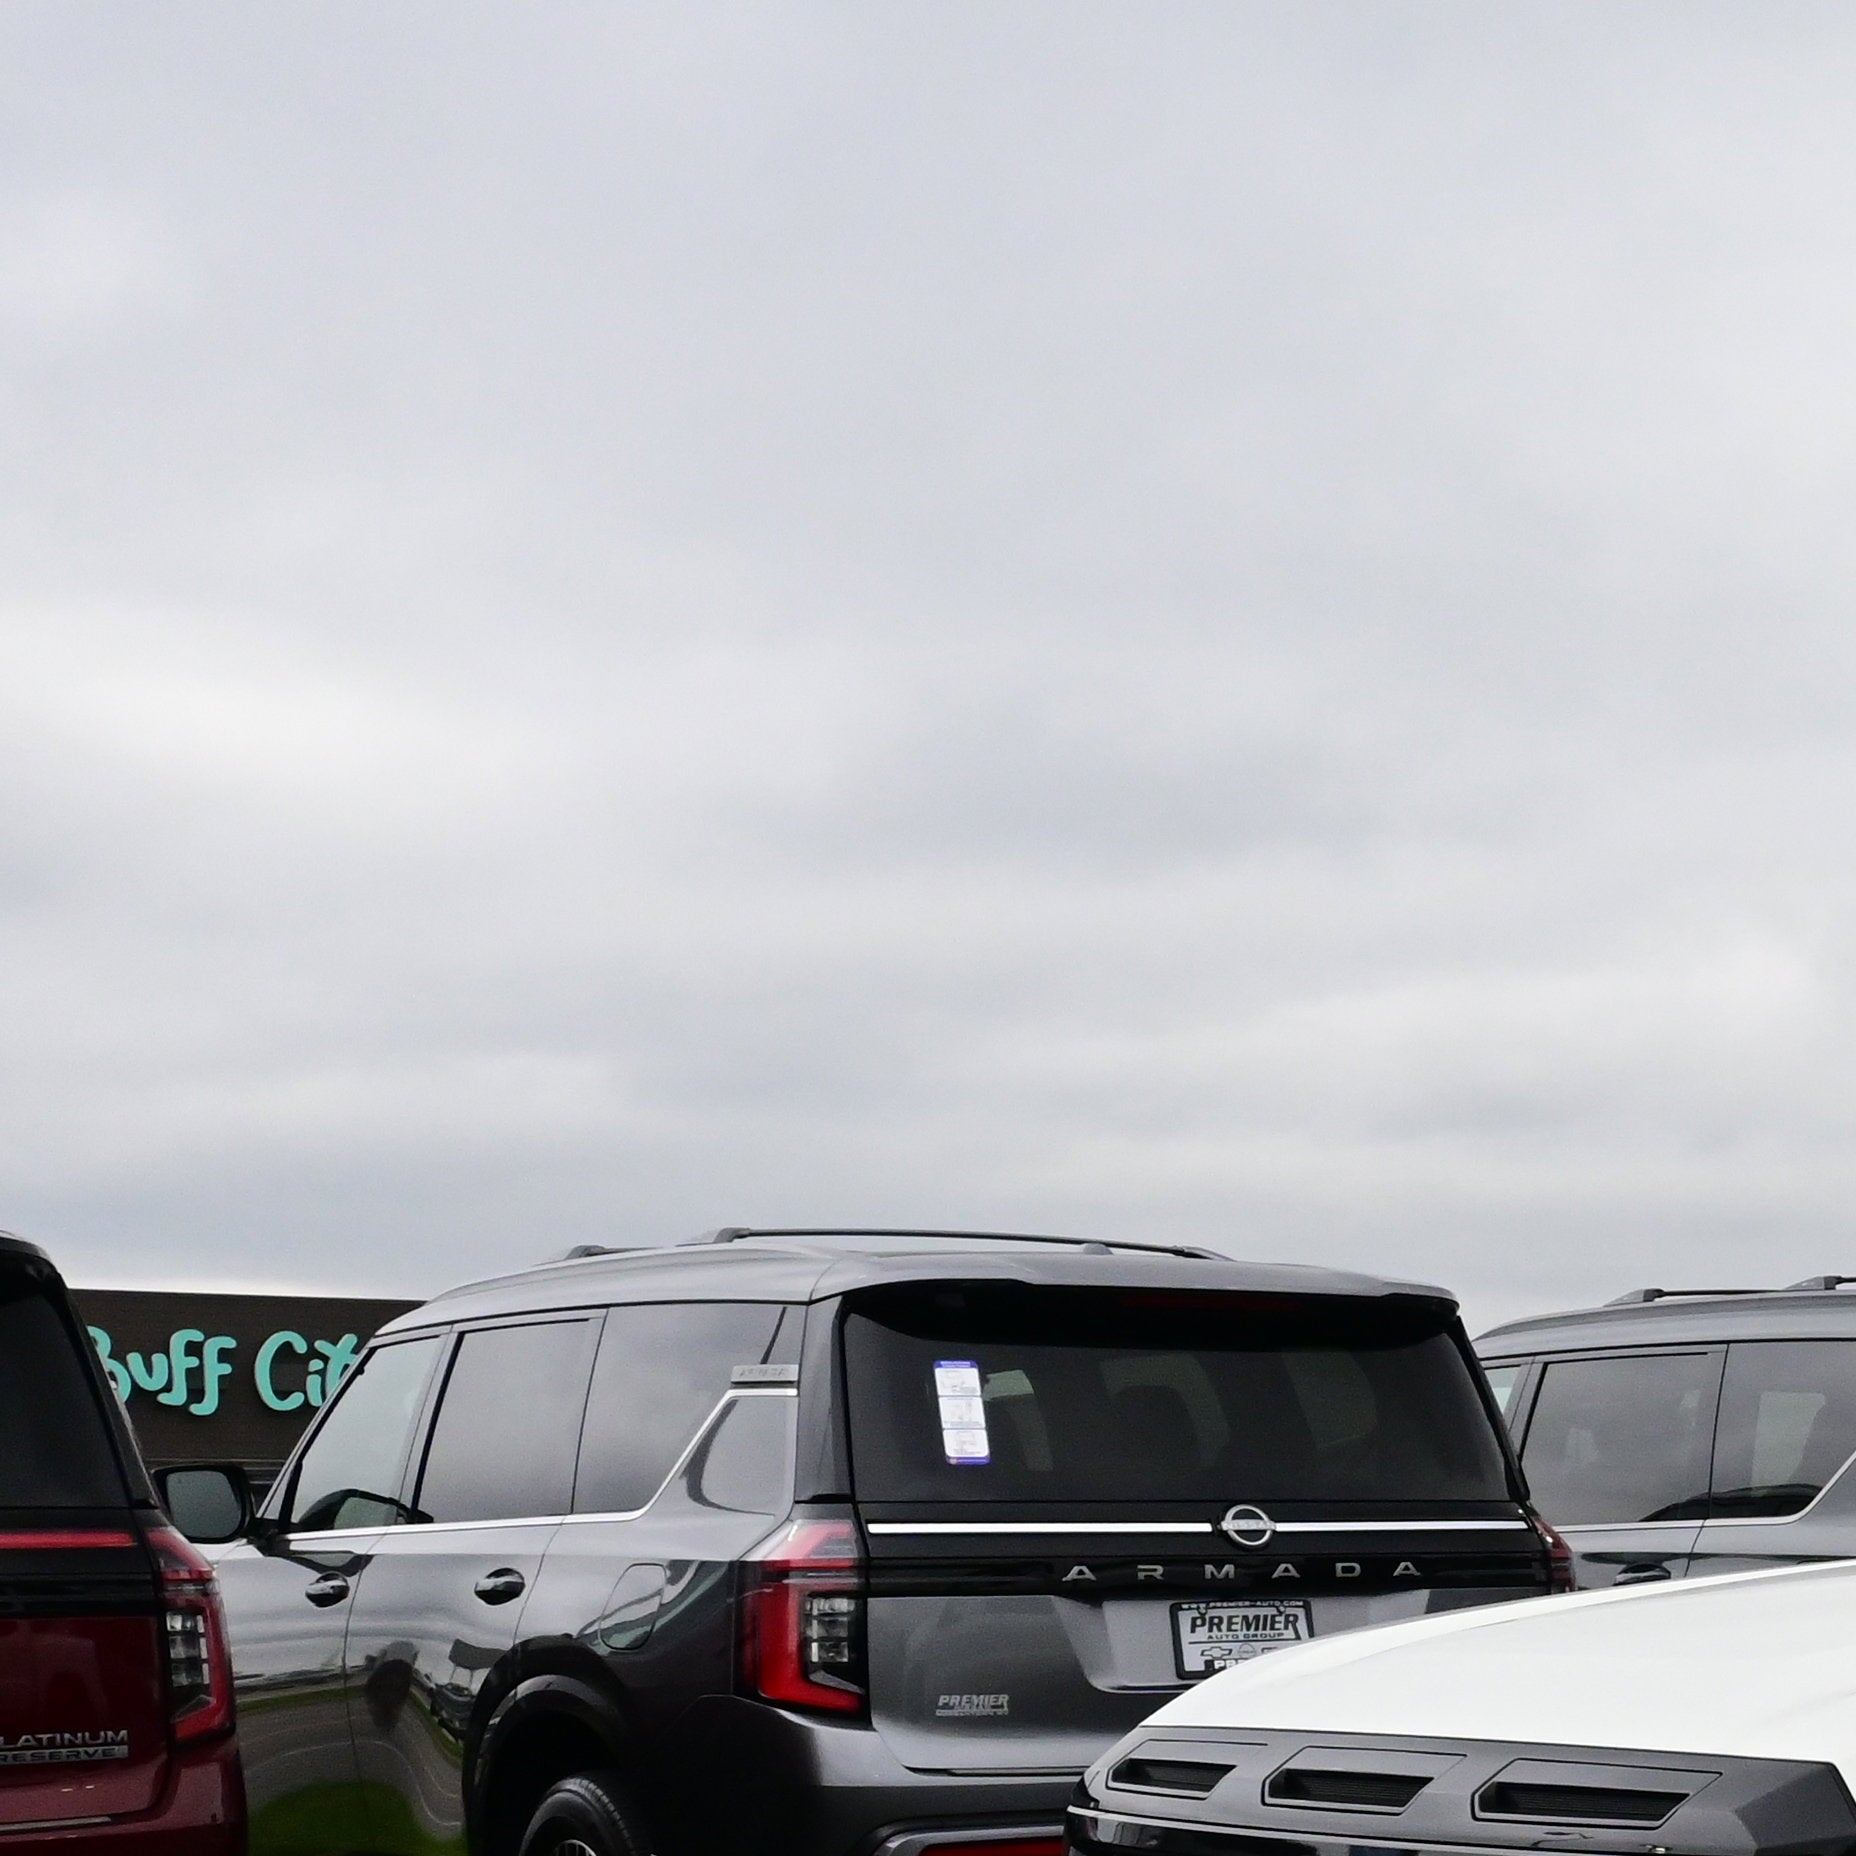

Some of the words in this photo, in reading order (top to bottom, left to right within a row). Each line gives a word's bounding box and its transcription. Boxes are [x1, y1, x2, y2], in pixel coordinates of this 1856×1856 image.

[254, 1330, 360, 1412] Cit
[1062, 1561, 1421, 1582] ARMADA
[1190, 1613, 1302, 1635] PREMIER
[938, 1694, 1009, 1706] PREMIER
[0, 1730, 128, 1748] LATINUM
